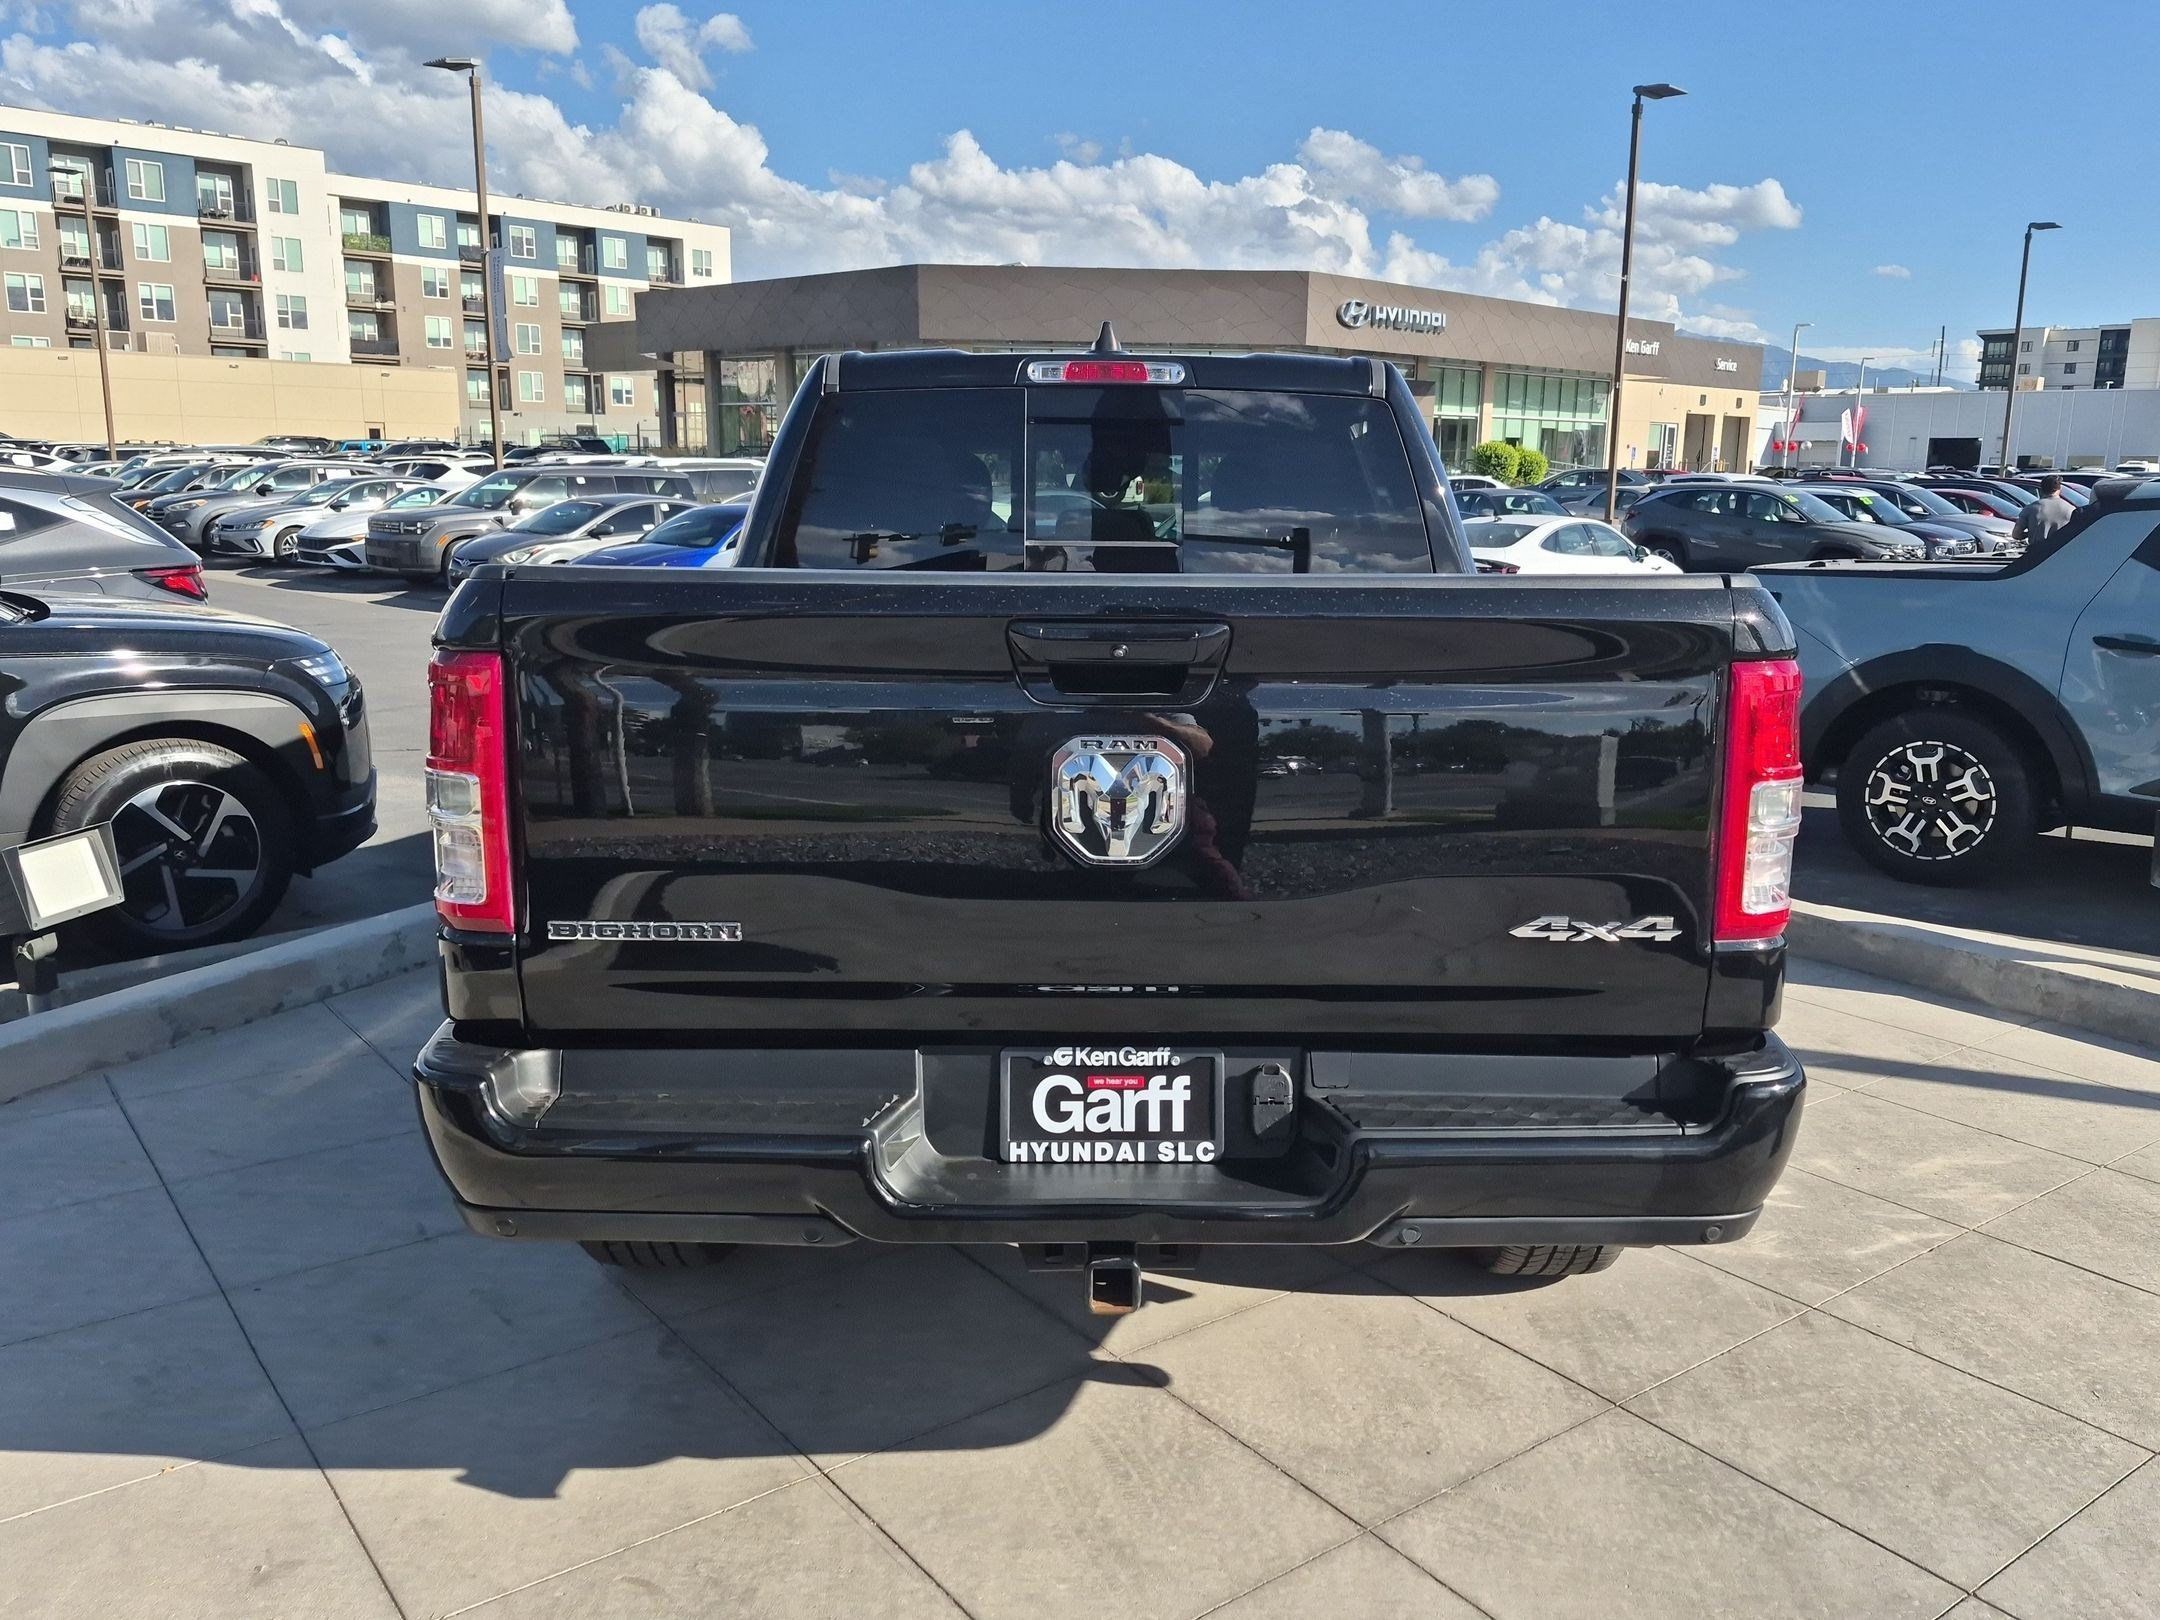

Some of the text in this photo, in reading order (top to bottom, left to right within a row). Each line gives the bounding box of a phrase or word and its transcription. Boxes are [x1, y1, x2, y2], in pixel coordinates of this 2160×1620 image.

[1374, 305, 1447, 329] HYUNDAI
[1625, 338, 1660, 355] Ken Garff
[1716, 357, 1738, 372] Service
[1079, 738, 1159, 751] RAM
[546, 920, 743, 942] BIGHORN
[1508, 915, 1683, 942] 4x4
[1075, 1046, 1171, 1067] Ken Garff
[1105, 1077, 1123, 1085] hear
[1124, 1078, 1139, 1086] you
[1032, 1074, 1191, 1134] Garff
[1009, 1141, 1215, 1163] HYUNDAI SLC
